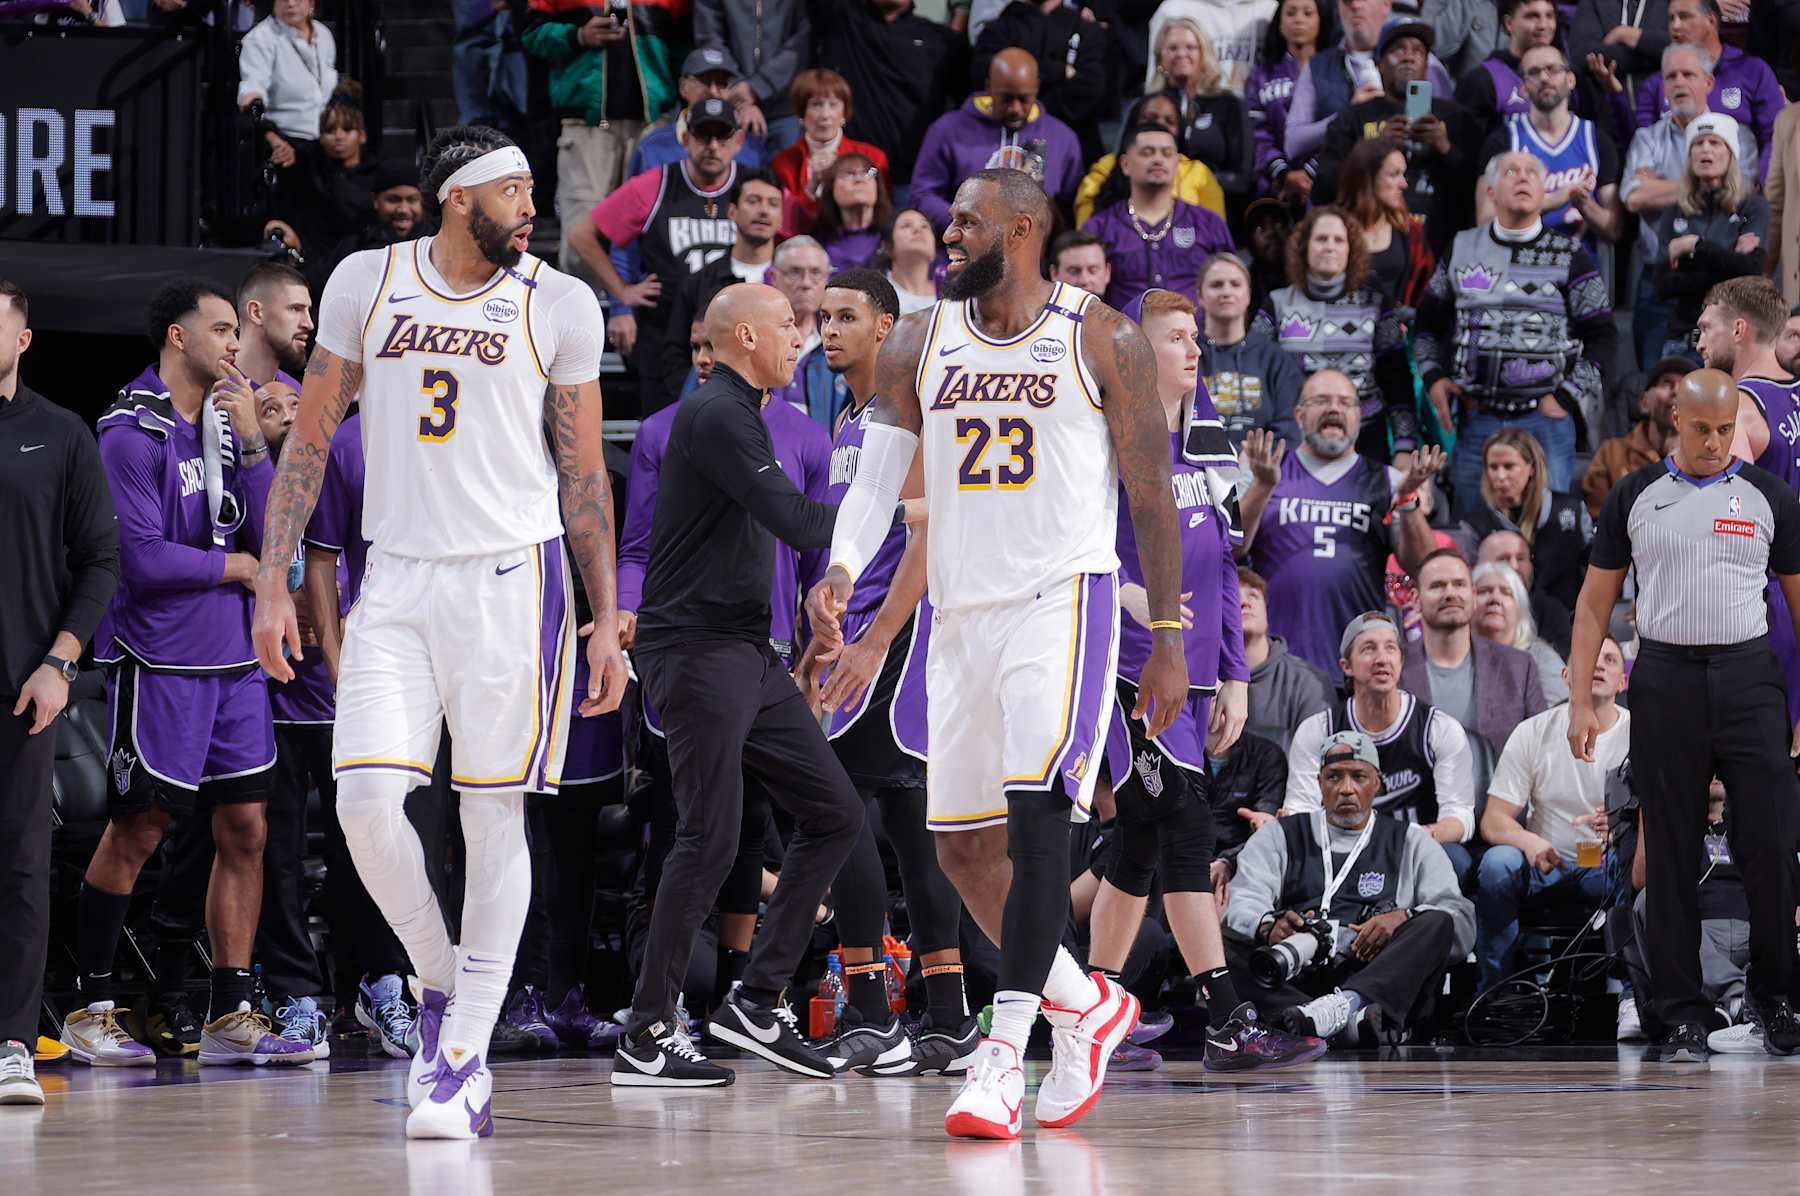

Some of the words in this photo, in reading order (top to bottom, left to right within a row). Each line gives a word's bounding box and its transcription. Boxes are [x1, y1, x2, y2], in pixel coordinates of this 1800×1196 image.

[0, 107, 117, 217] RE
[486, 303, 517, 318] bibigo
[376, 313, 510, 367] LAKERS
[1033, 343, 1064, 356] bibigo
[417, 368, 459, 443] 3
[929, 365, 1058, 411] LAKERS
[955, 416, 1036, 491] 23
[1313, 525, 1336, 558] 5
[1714, 521, 1754, 535] Emirates
